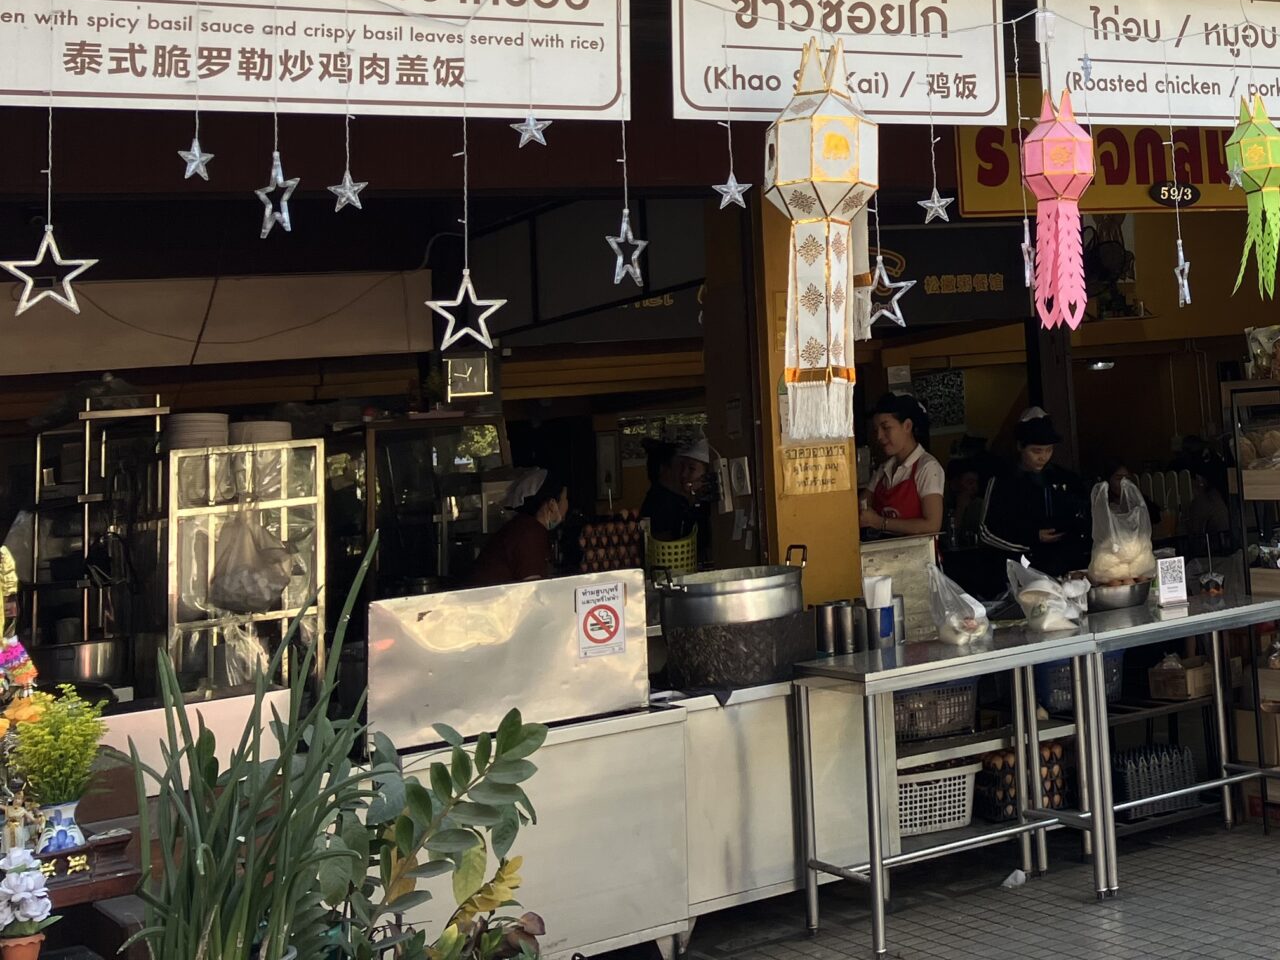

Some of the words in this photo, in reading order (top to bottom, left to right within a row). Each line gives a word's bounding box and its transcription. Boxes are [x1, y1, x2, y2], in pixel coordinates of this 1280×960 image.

[34, 9, 78, 27] with
[87, 12, 140, 34] spicy
[147, 13, 193, 32] basil
[200, 20, 255, 35] sauce
[262, 21, 297, 37] and
[304, 23, 356, 44] crispy
[363, 24, 403, 42] basil
[410, 26, 464, 44] leaves
[470, 32, 524, 47] served
[531, 33, 564, 49] with
[570, 35, 605, 53] rice)
[1090, 5, 1161, 43] ไก่อบ
[1175, 14, 1191, 48] /
[1204, 22, 1277, 58] หมูอบ
[63, 40, 465, 88] 泰式脆罗勒炒鸡肉盖饭
[703, 65, 781, 95] (Khao
[900, 71, 915, 98] /
[927, 72, 979, 100] 鸡饭
[1065, 71, 1146, 96] (Roasted
[1155, 73, 1221, 97] chicken
[1229, 76, 1239, 99] /
[1159, 185, 1193, 202] 59/3
